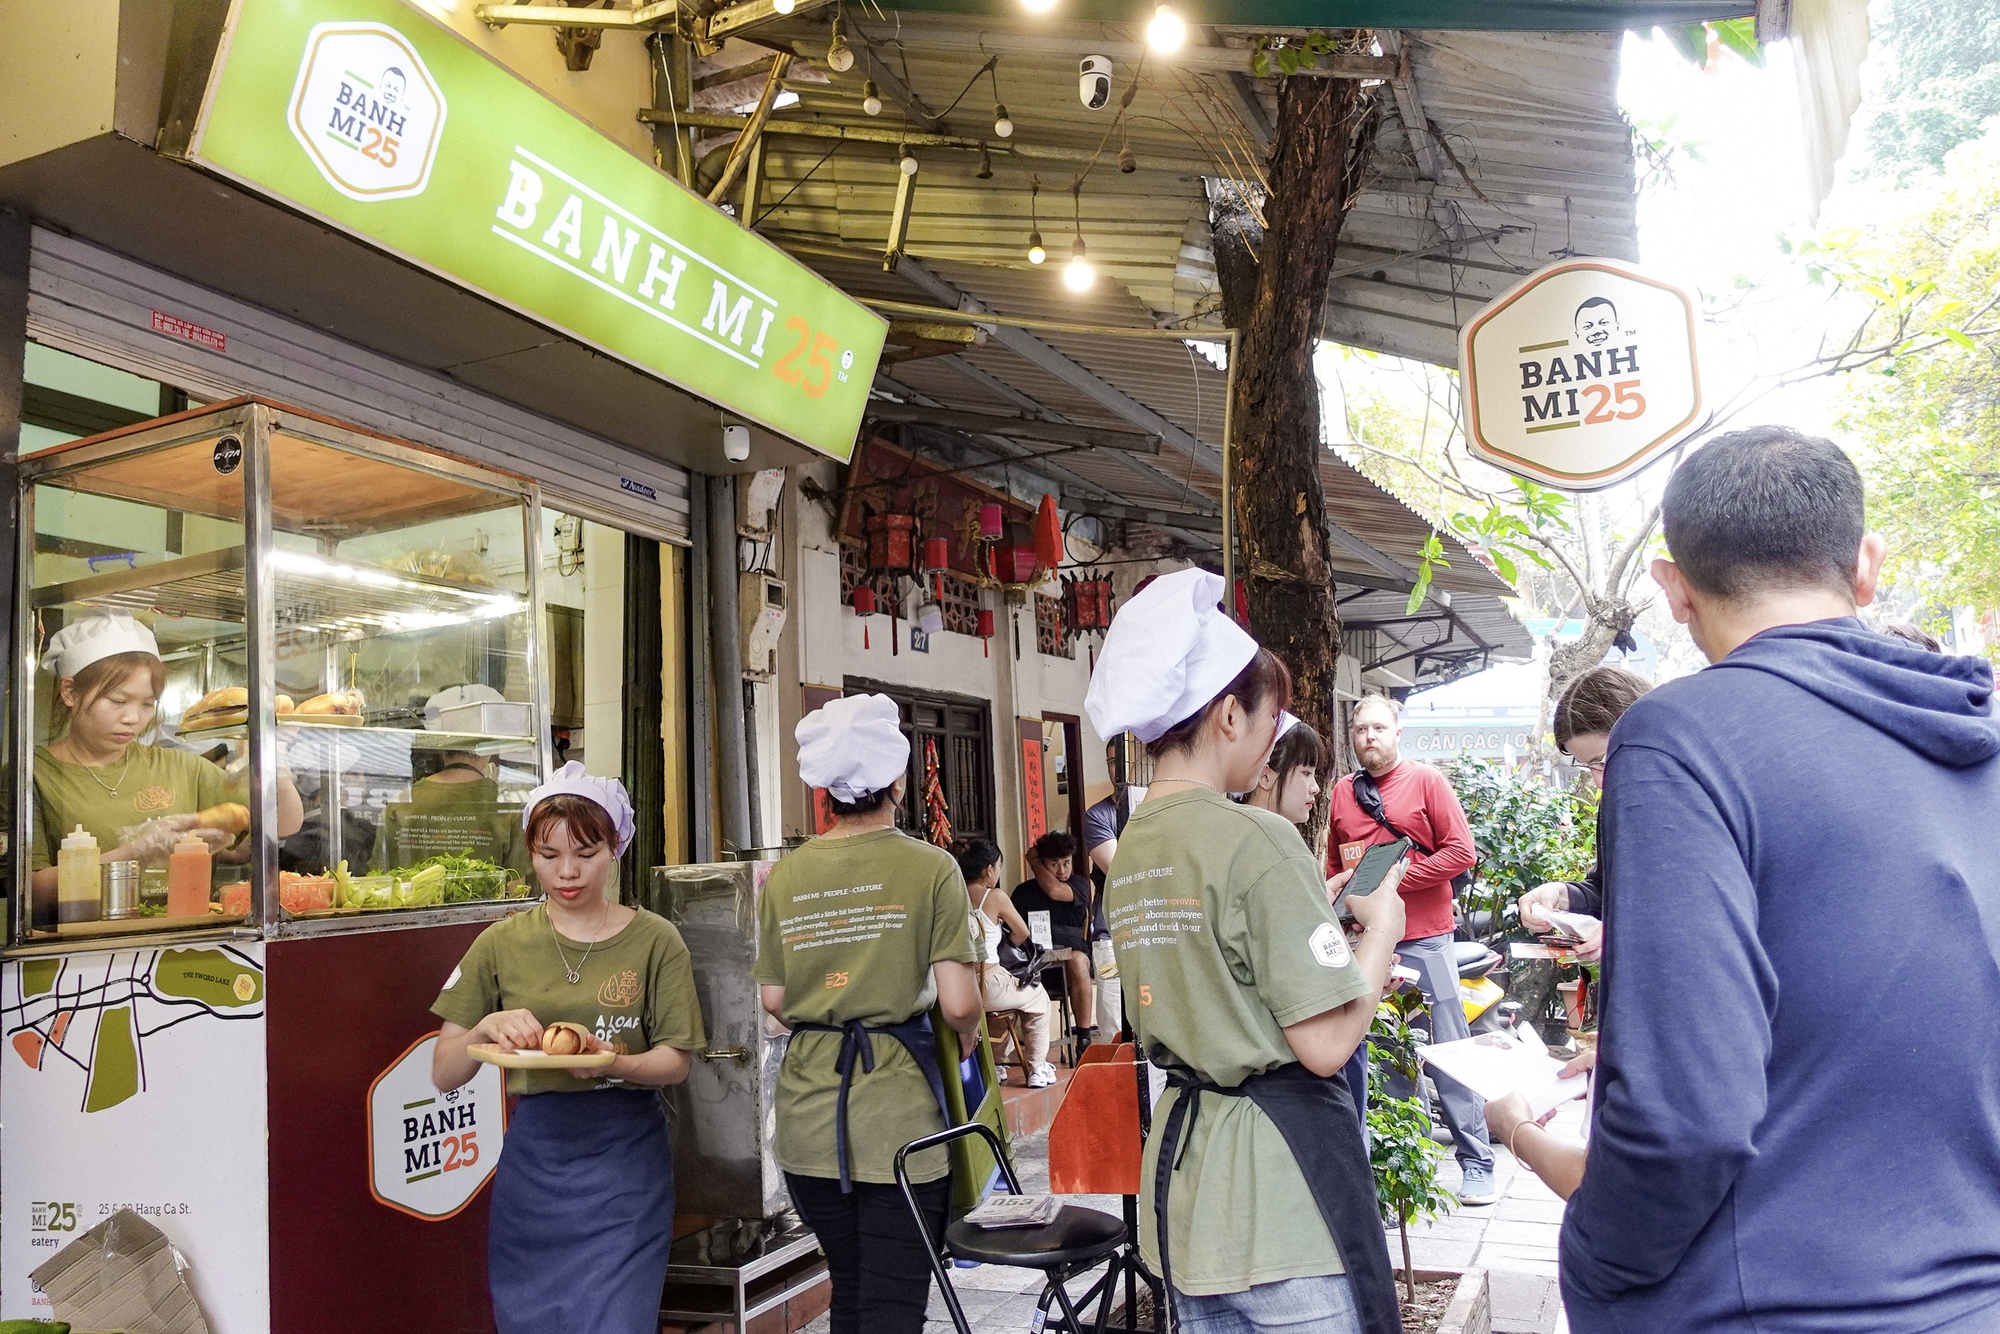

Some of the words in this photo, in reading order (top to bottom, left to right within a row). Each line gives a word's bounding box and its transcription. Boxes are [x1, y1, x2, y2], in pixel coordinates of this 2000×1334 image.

[336, 81, 406, 137] BANH
[496, 160, 688, 311] BANH
[1519, 344, 1640, 390] BANH
[214, 450, 240, 460] C-17A
[914, 631, 926, 650] 27
[1461, 728, 1500, 750] CÁC
[1344, 846, 1362, 860] 020
[150, 886, 169, 894] world
[824, 888, 849, 898] PEOPLE
[852, 883, 884, 894] CULTURE
[802, 913, 819, 921] world
[848, 906, 865, 915] better
[876, 912, 907, 922] employees
[1034, 925, 1047, 934] 064
[195, 972, 215, 982] SWORD
[215, 976, 230, 986] LAKE
[596, 1014, 605, 1028] A
[609, 1015, 640, 1034] LOAF
[595, 1029, 613, 1042] OF
[403, 1102, 476, 1143] BANH
[991, 1198, 1034, 1206] 053
[99, 1203, 109, 1214] 25
[136, 1203, 161, 1216] Hang
[164, 1203, 176, 1214] Ca
[179, 1203, 192, 1214] St.
[31, 1237, 59, 1248] eatery
